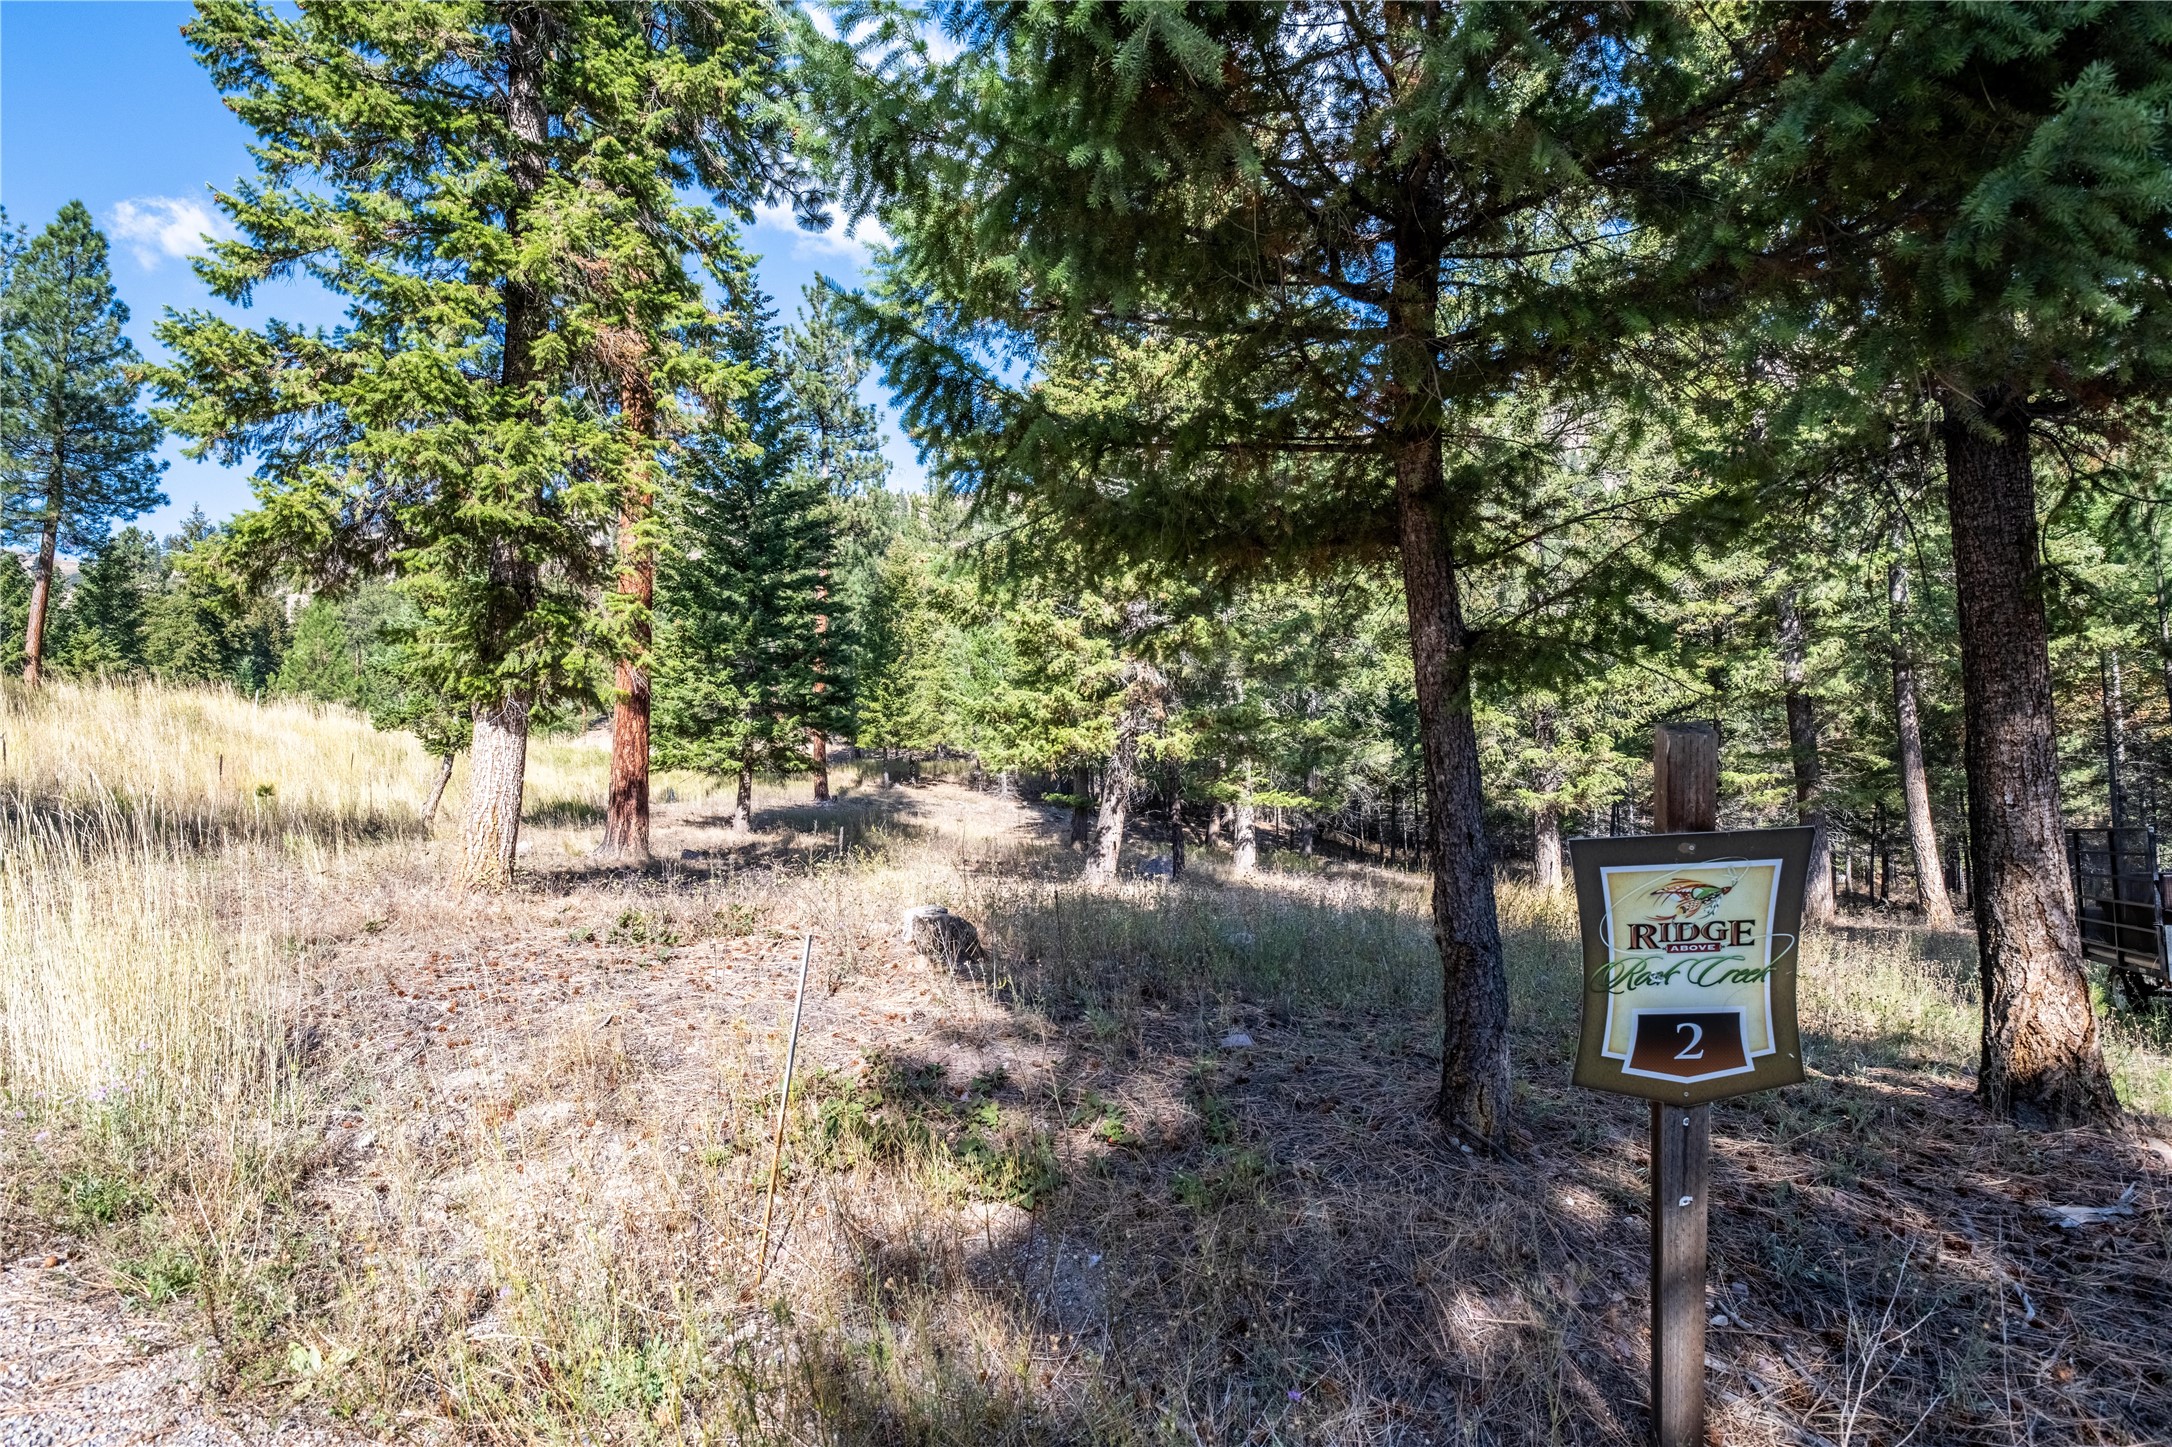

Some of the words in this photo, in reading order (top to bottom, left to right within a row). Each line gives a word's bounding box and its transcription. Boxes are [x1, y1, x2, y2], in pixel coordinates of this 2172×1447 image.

[1627, 919, 1755, 950] RIDGE
[1670, 944, 1716, 953] ABOVE
[1687, 955, 1777, 987] Creek
[1674, 1022, 1704, 1060] 2
